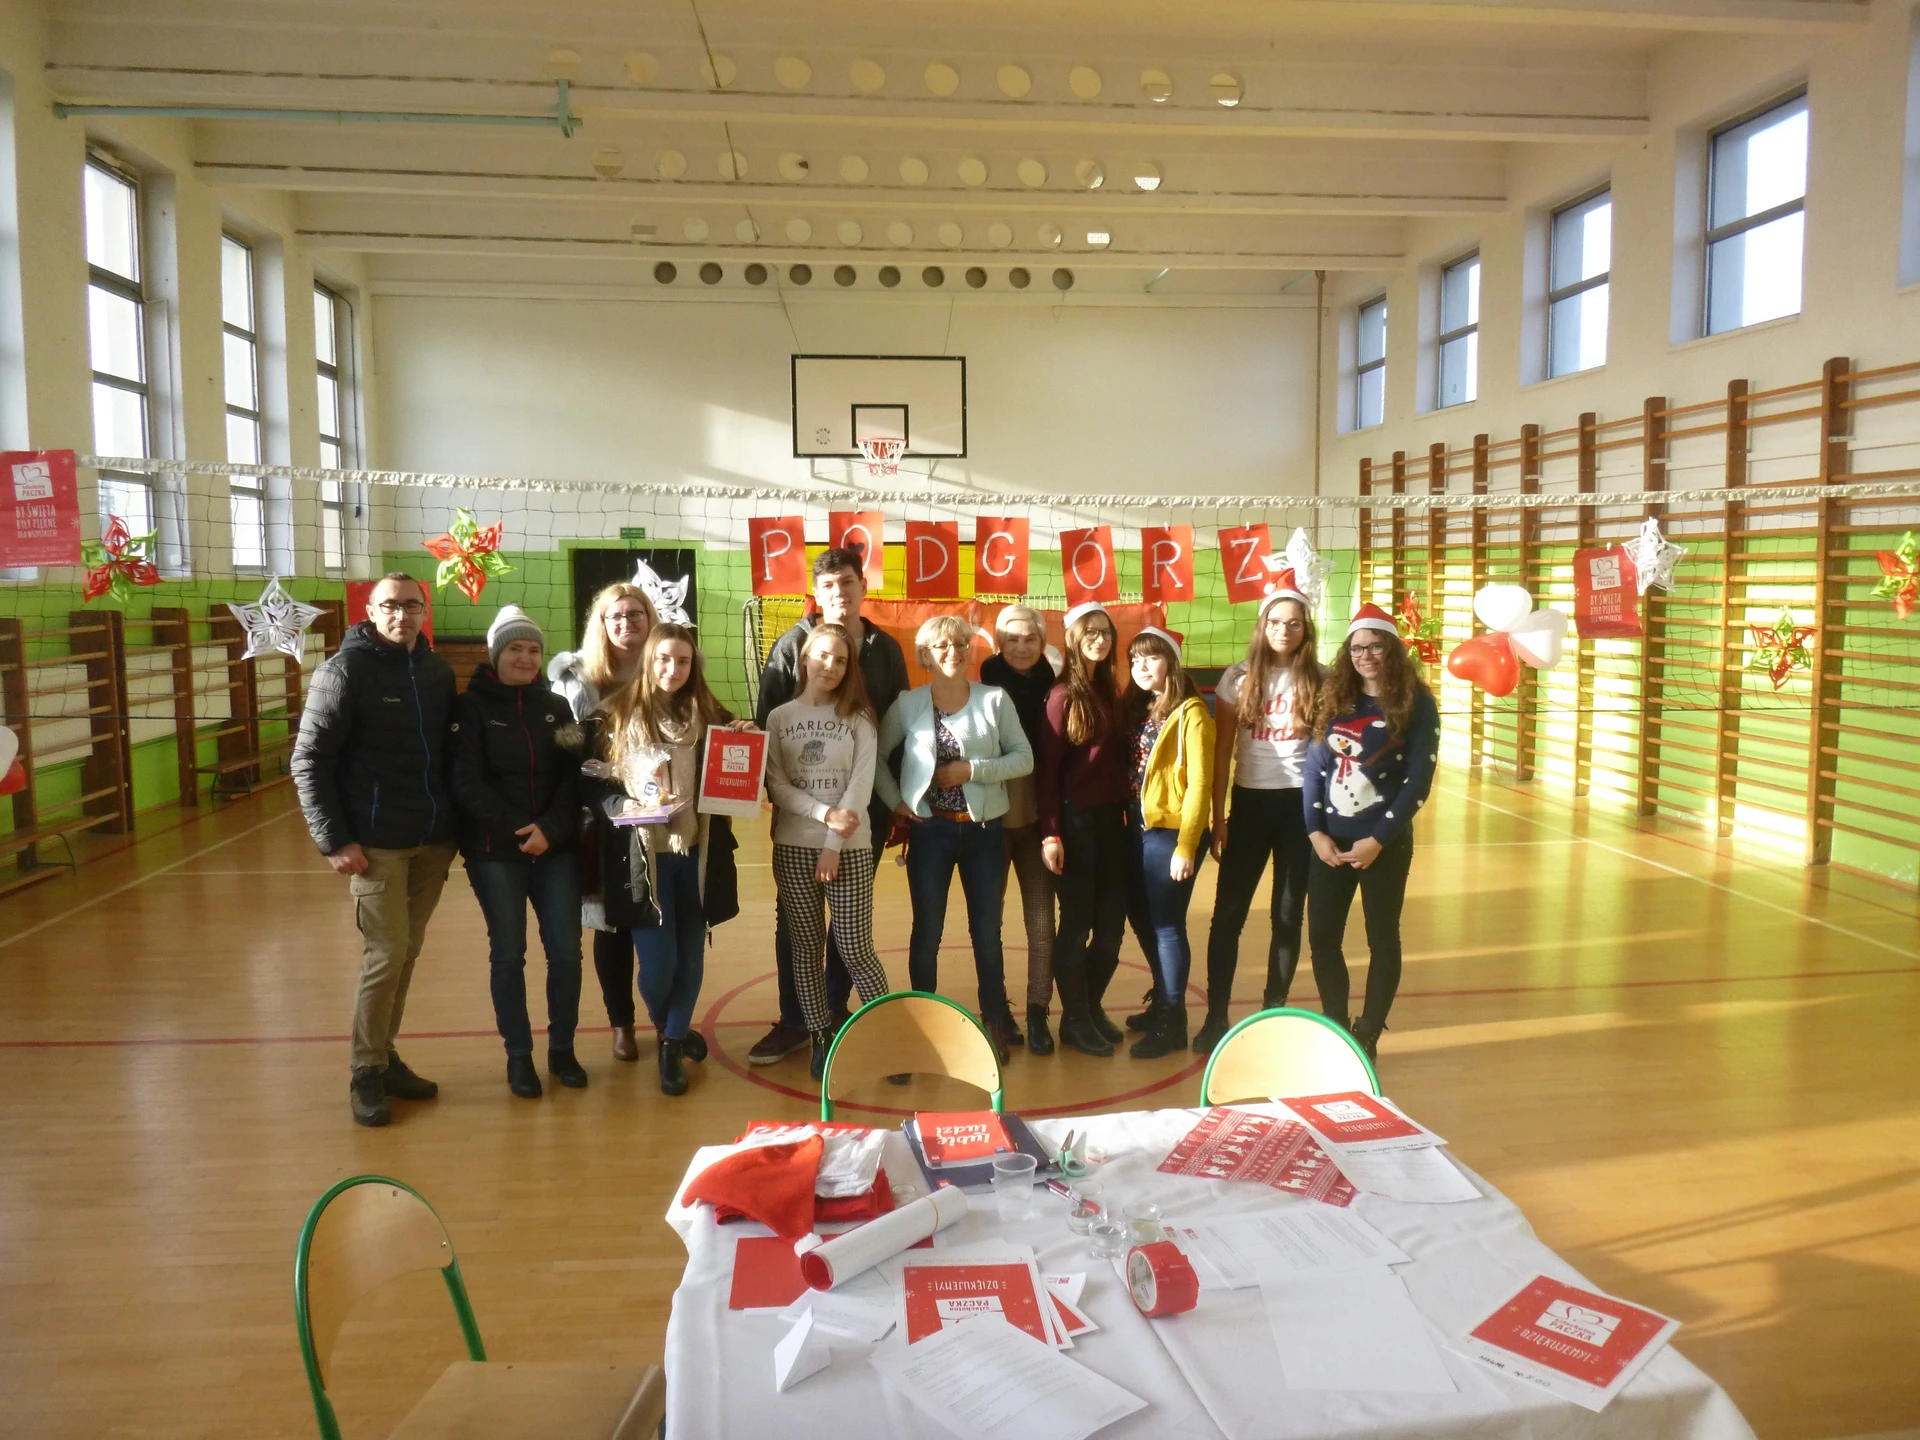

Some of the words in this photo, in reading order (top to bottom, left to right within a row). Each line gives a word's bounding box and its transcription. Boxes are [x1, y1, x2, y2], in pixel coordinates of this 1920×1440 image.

[22, 489, 46, 497] PACZKA
[791, 733, 807, 741] AUX
[810, 731, 842, 742] FRAISES
[936, 1124, 987, 1136] ludzi
[936, 1132, 991, 1147] lubię
[934, 1280, 999, 1291] DZIĘKUJEMY!
[1549, 1321, 1592, 1341] PACZKA
[1555, 1318, 1596, 1336] szlachetna
[1520, 1329, 1592, 1362] DZIĘKUJEMY!
